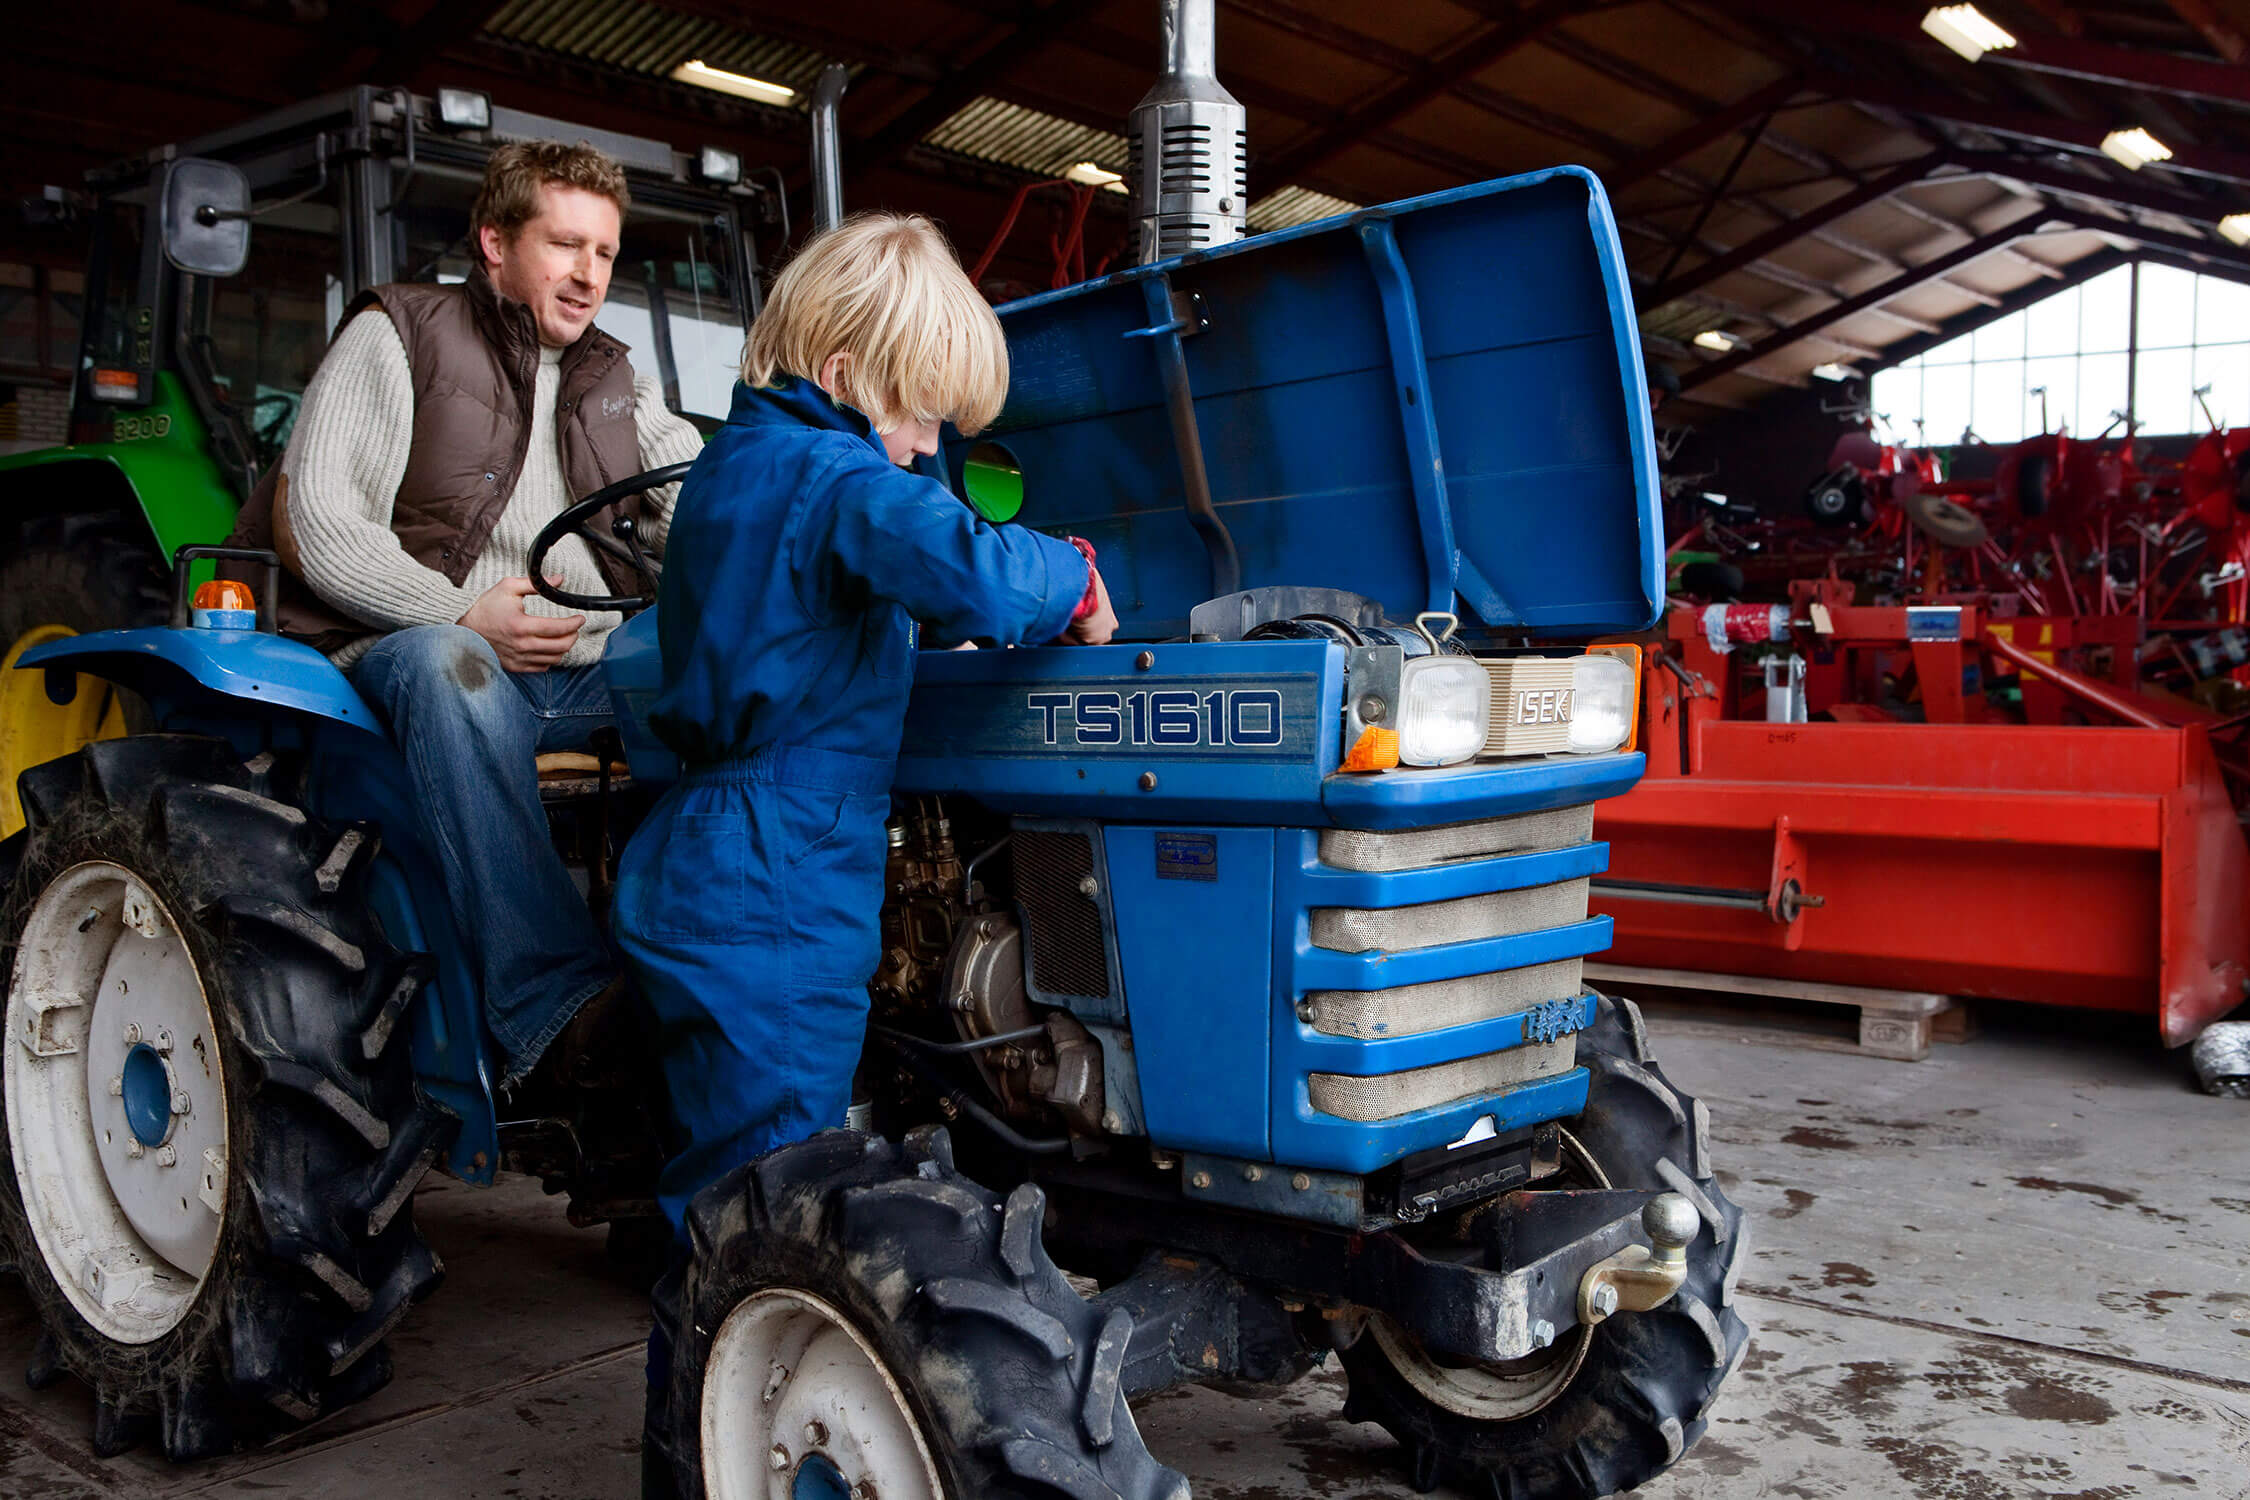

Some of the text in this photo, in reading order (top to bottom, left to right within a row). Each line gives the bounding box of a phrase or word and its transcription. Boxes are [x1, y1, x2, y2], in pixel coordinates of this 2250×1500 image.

[113, 414, 171, 442] 3200
[1027, 689, 1283, 746] TS1610
[1517, 689, 1577, 724] ISEKI
